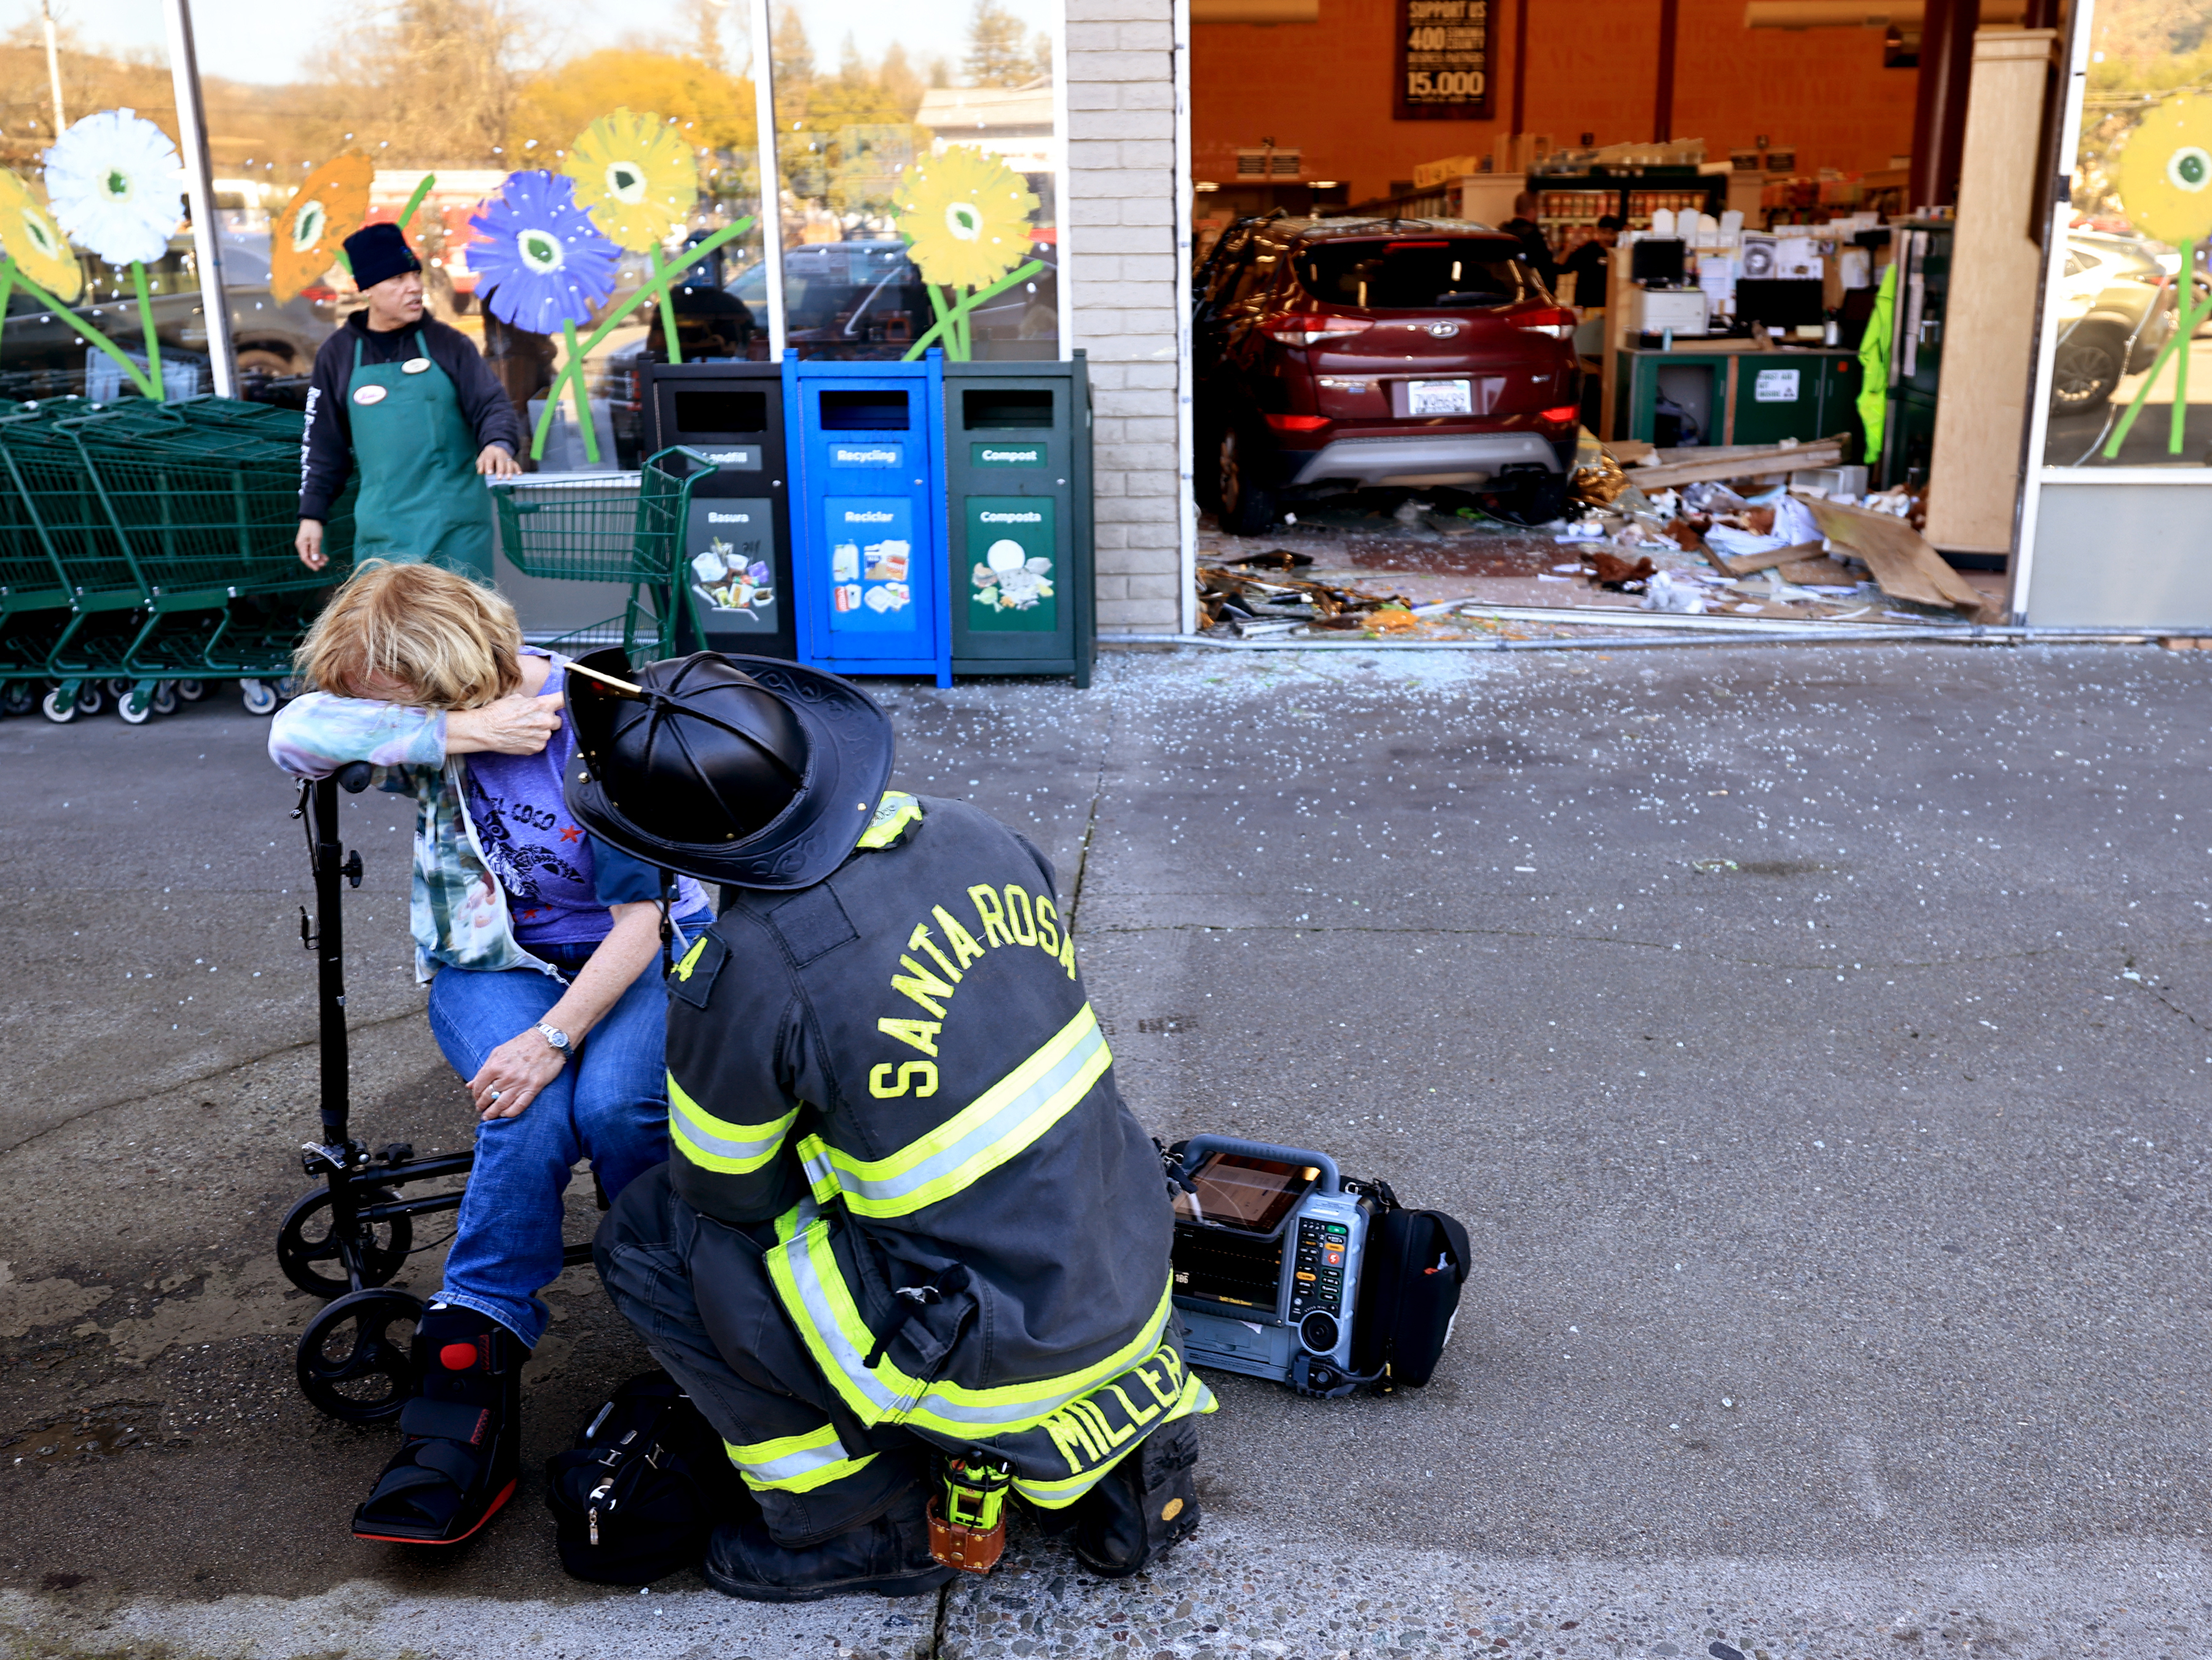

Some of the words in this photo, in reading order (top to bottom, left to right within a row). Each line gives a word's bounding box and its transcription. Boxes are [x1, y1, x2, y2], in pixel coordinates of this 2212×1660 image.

[1408, 26, 1445, 50] 400
[837, 449, 896, 464] Recycling
[982, 449, 1038, 463] Compost
[708, 511, 750, 523] Basura
[845, 511, 894, 523] Reciclar
[979, 511, 1042, 524] Composta
[511, 803, 557, 831] COCO
[869, 904, 987, 1099] SANTA
[967, 883, 1077, 982] ROSA
[1038, 1344, 1184, 1474] MILLER
